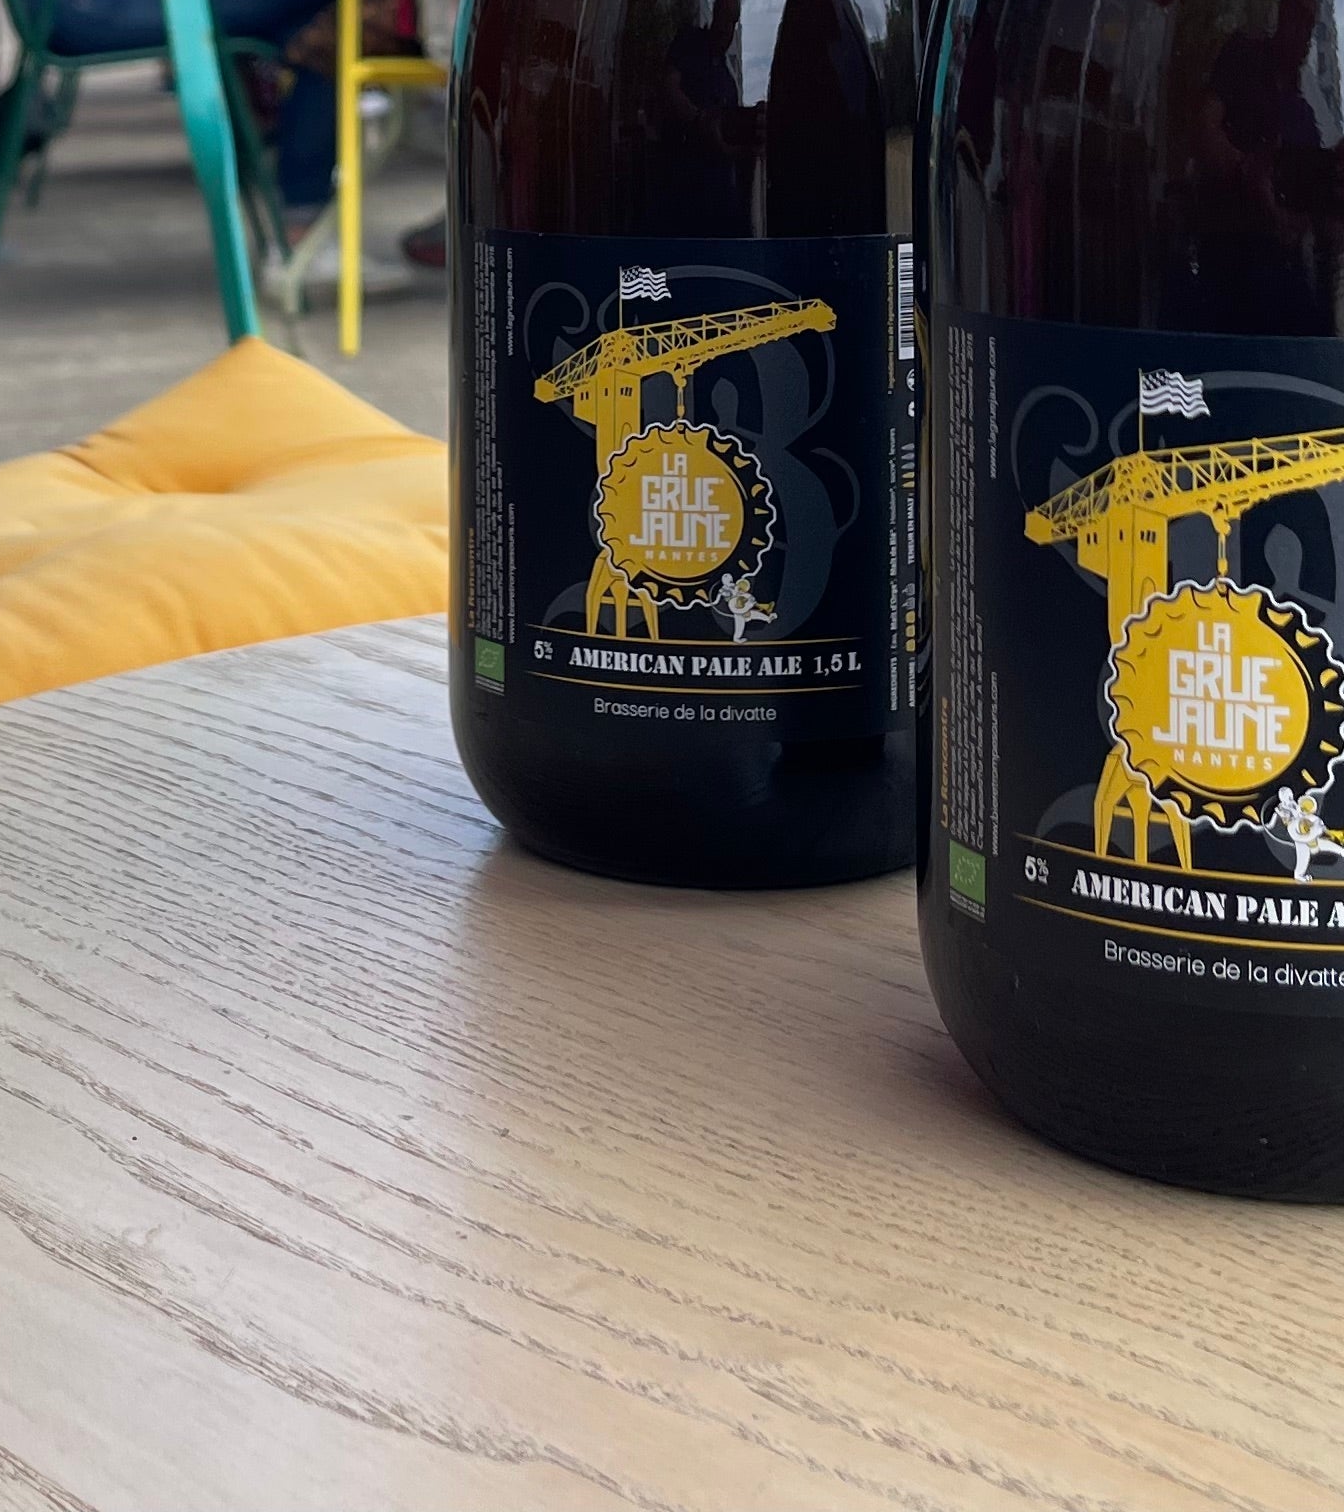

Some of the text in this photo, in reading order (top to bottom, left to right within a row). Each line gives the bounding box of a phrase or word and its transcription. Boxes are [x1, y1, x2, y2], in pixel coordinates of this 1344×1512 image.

[662, 453, 687, 475] LA
[642, 475, 722, 512] GRUE
[629, 510, 731, 548] JAUNE
[645, 550, 718, 562] NANTES
[1197, 621, 1231, 653] LA
[569, 646, 684, 675] AMERICAN
[691, 656, 752, 676] PALE
[757, 656, 802, 676] ALE
[813, 653, 842, 676] 1,5
[848, 651, 861, 671] L
[1168, 648, 1278, 704] GRUE
[594, 697, 777, 721] Brasserie de la divatte
[1151, 696, 1291, 753] JAUNE
[940, 696, 948, 829] La Rencontre
[1173, 748, 1273, 771] NANTES
[1071, 869, 1226, 920] AMERICAN
[1236, 894, 1319, 928] PALE
[1104, 939, 1205, 976] Brasserie
[1212, 957, 1240, 980] de
[1248, 960, 1268, 983] la
